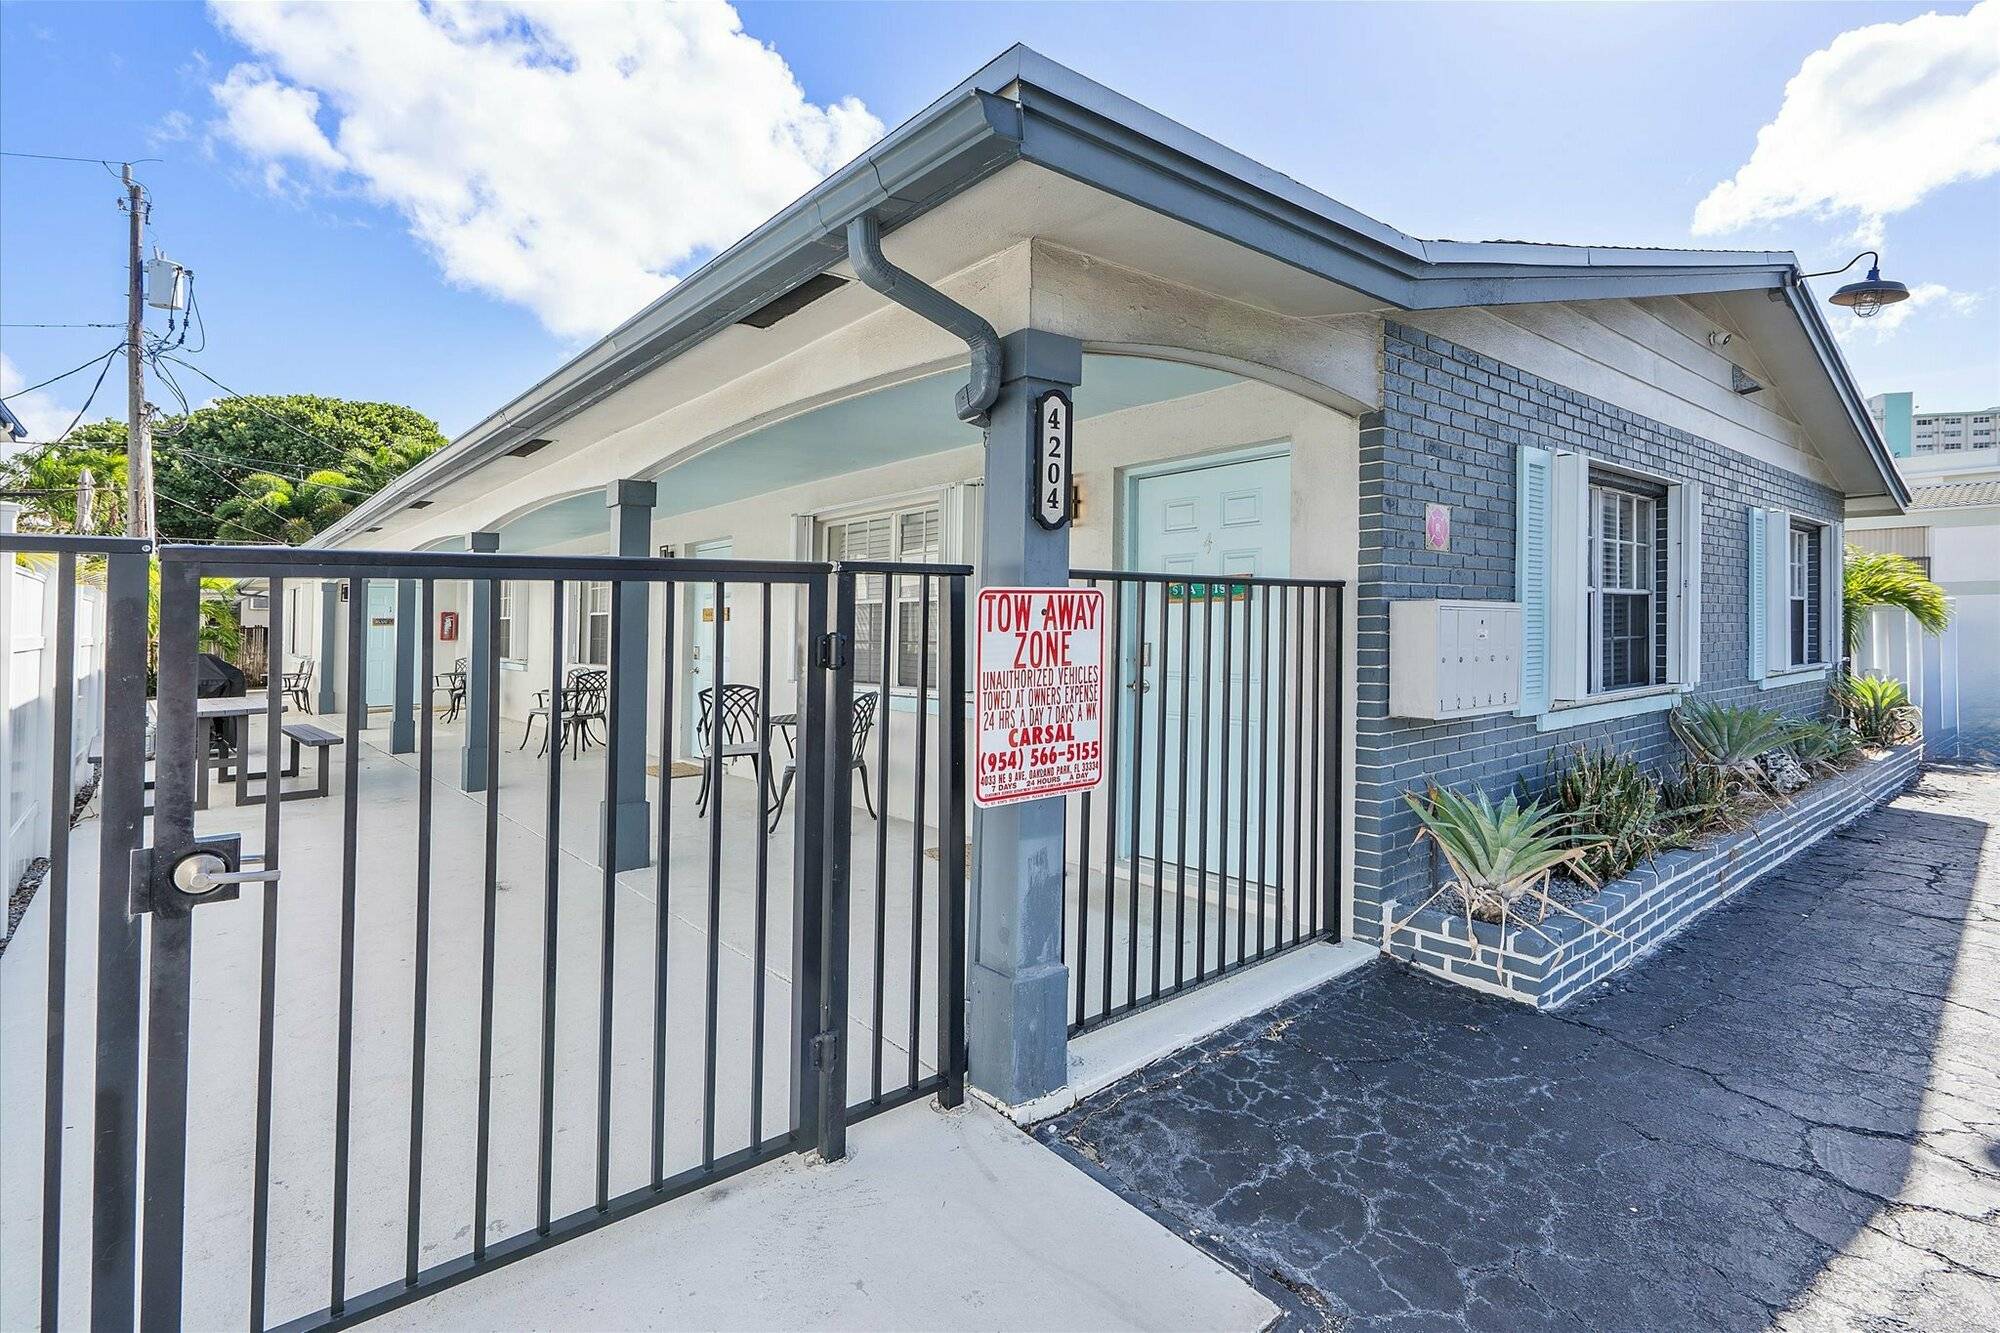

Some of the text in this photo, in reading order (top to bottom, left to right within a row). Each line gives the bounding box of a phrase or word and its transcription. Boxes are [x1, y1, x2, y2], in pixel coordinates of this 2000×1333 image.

[1047, 408, 1061, 509] 4204
[985, 594, 1099, 632] TOW AWAY
[1013, 631, 1072, 669] ZONE
[983, 665, 1098, 690] UNAUTHORIZED VEHICLES
[983, 684, 1098, 711] TOWED AT OWNERS EXPENSE
[1440, 692, 1507, 711] 1 2 3 4 5
[983, 703, 1097, 731] 24 HRS A DAY 7 DAYS A WK
[1008, 723, 1075, 748] CARSAL
[981, 741, 1099, 775] (954) 566-5155
[980, 775, 996, 787] 4033
[1008, 772, 1013, 782] 9
[1028, 768, 1055, 780] OAKLAND
[1074, 765, 1081, 773] FL
[991, 784, 996, 792] 7
[998, 782, 1017, 791] DAYS
[1026, 779, 1036, 787] 24
[1036, 776, 1061, 785] HOURS
[1075, 772, 1089, 780] DAY
